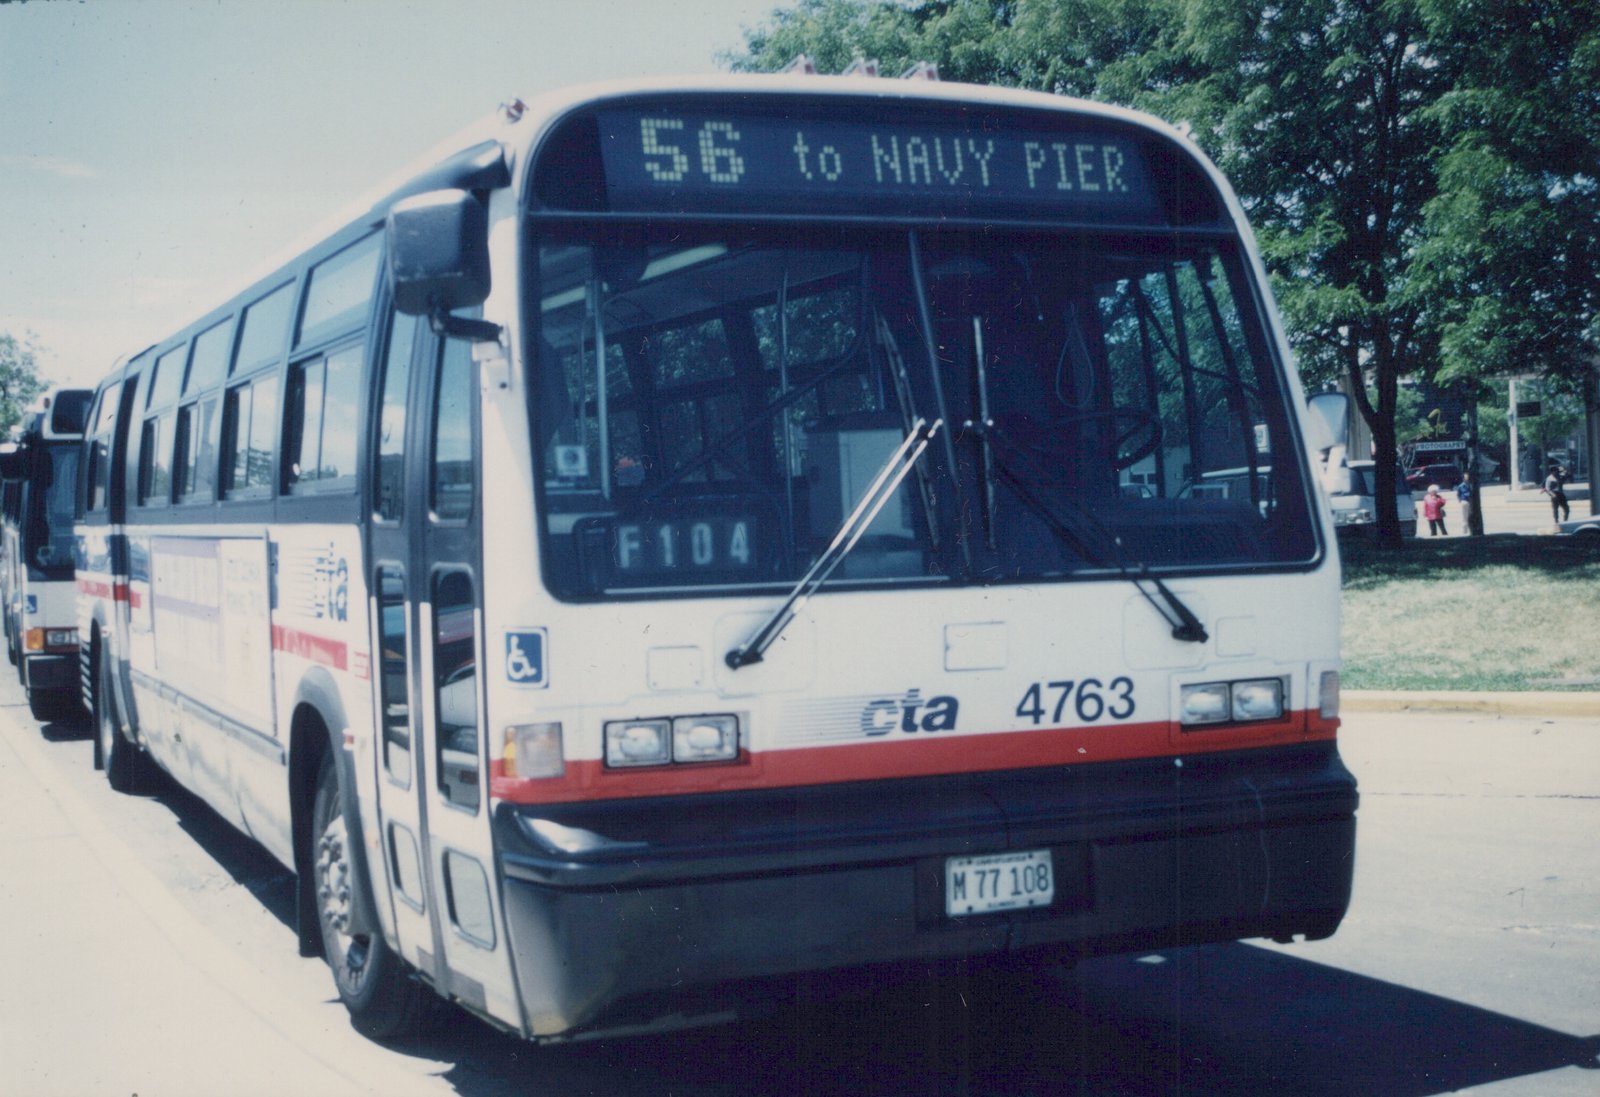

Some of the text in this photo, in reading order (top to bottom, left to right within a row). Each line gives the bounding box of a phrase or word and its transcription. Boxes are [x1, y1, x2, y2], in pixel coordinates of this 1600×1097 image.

[640, 118, 1129, 193] 56 to NAVY PIER
[1015, 676, 1136, 726] 4763
[953, 863, 1049, 901] M 77 108
